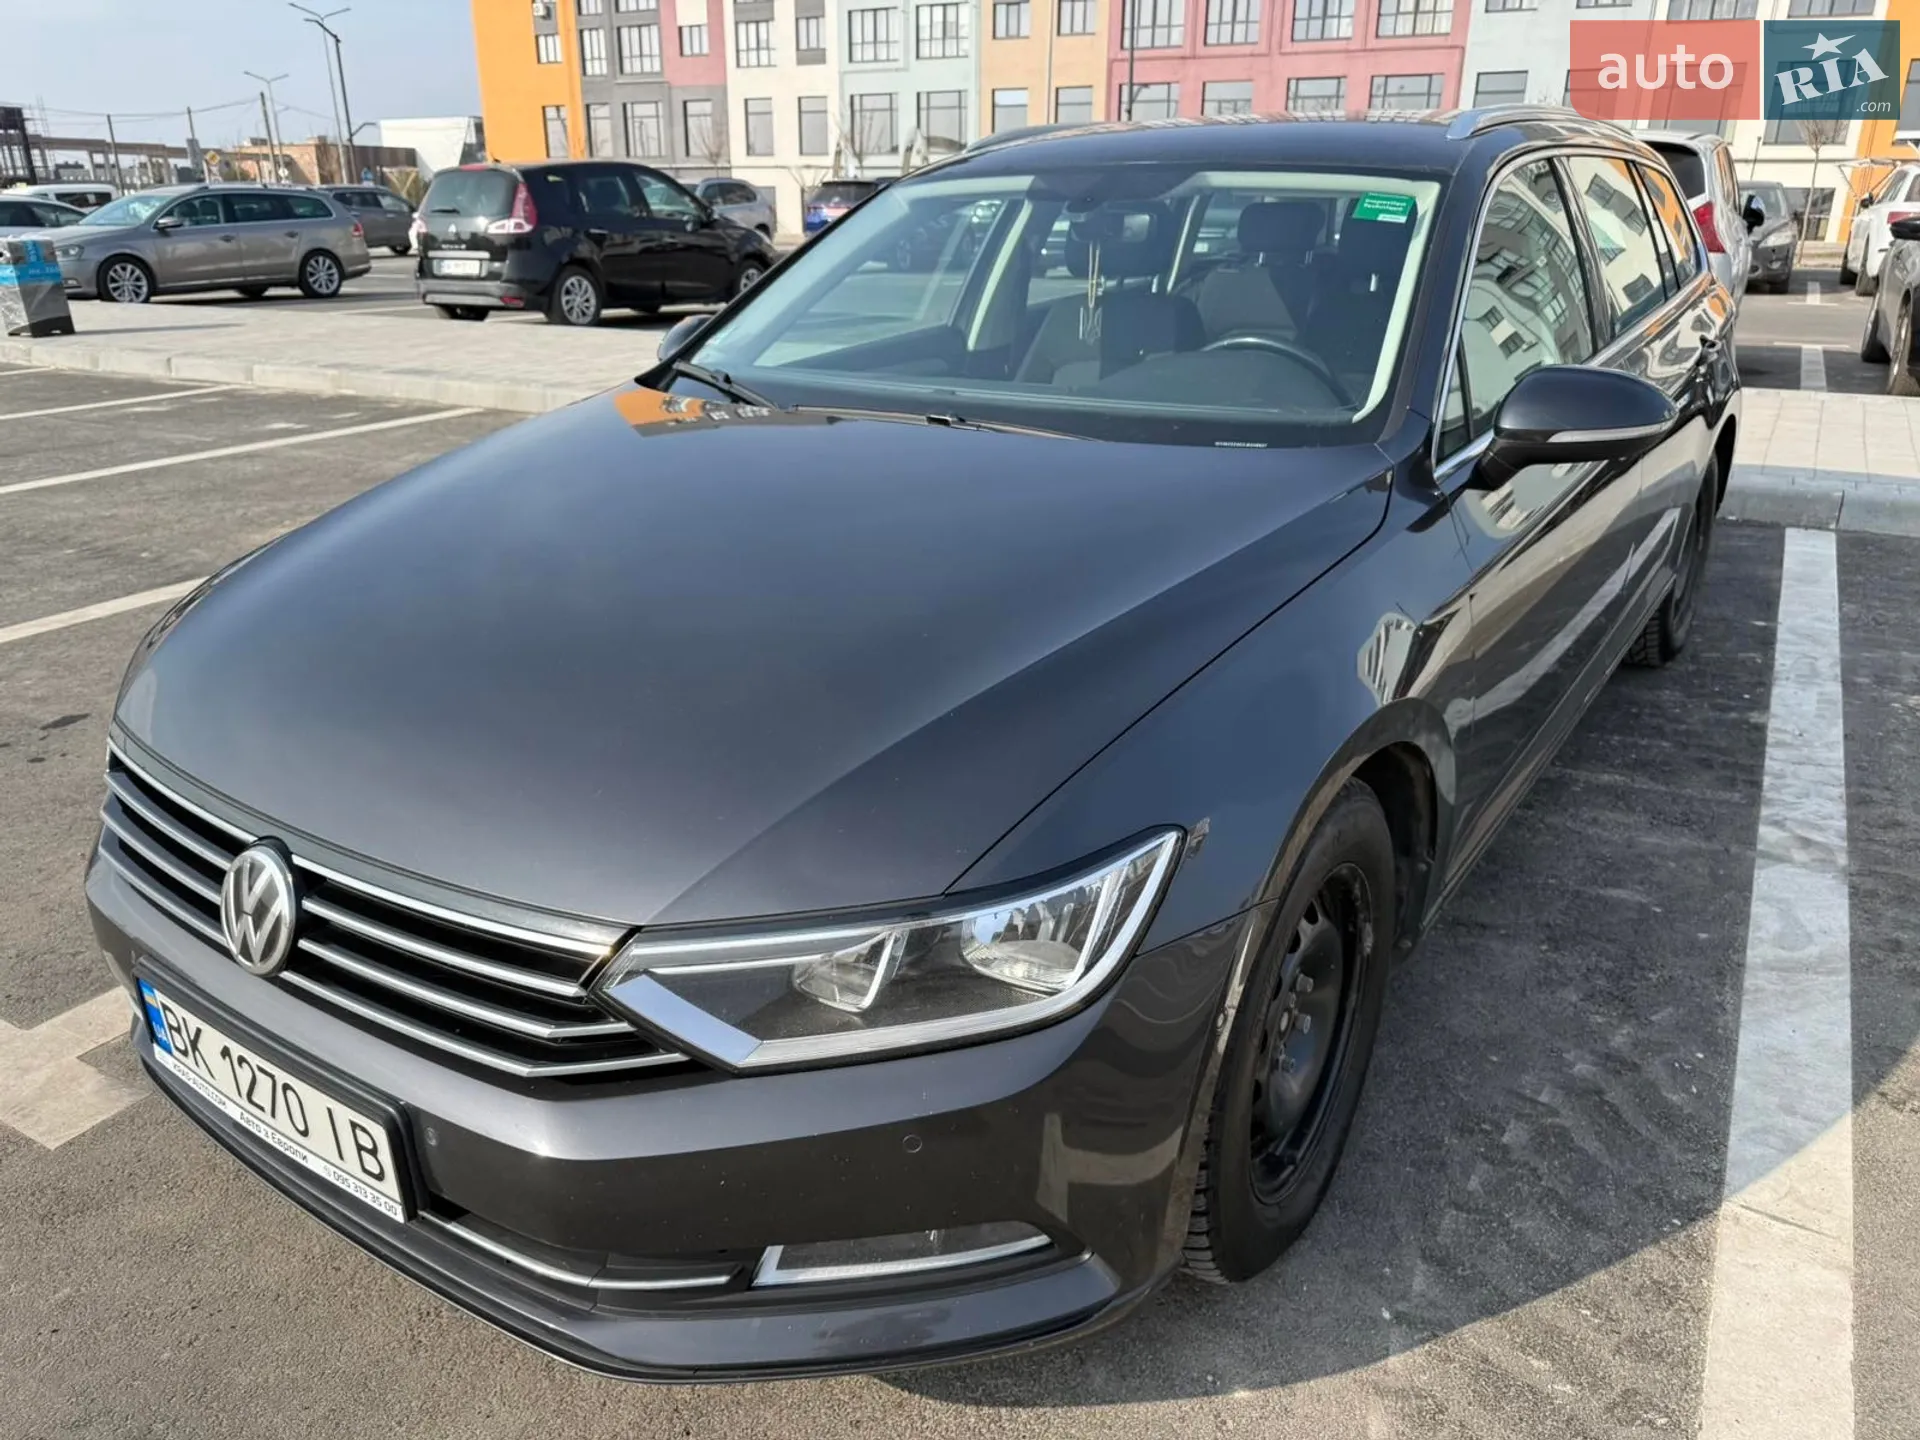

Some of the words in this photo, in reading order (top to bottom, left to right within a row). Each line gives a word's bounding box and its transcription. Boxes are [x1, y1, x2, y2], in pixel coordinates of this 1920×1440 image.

[160, 1001, 216, 1080] BK
[220, 1045, 309, 1138] 1270
[326, 1106, 386, 1182] IB
